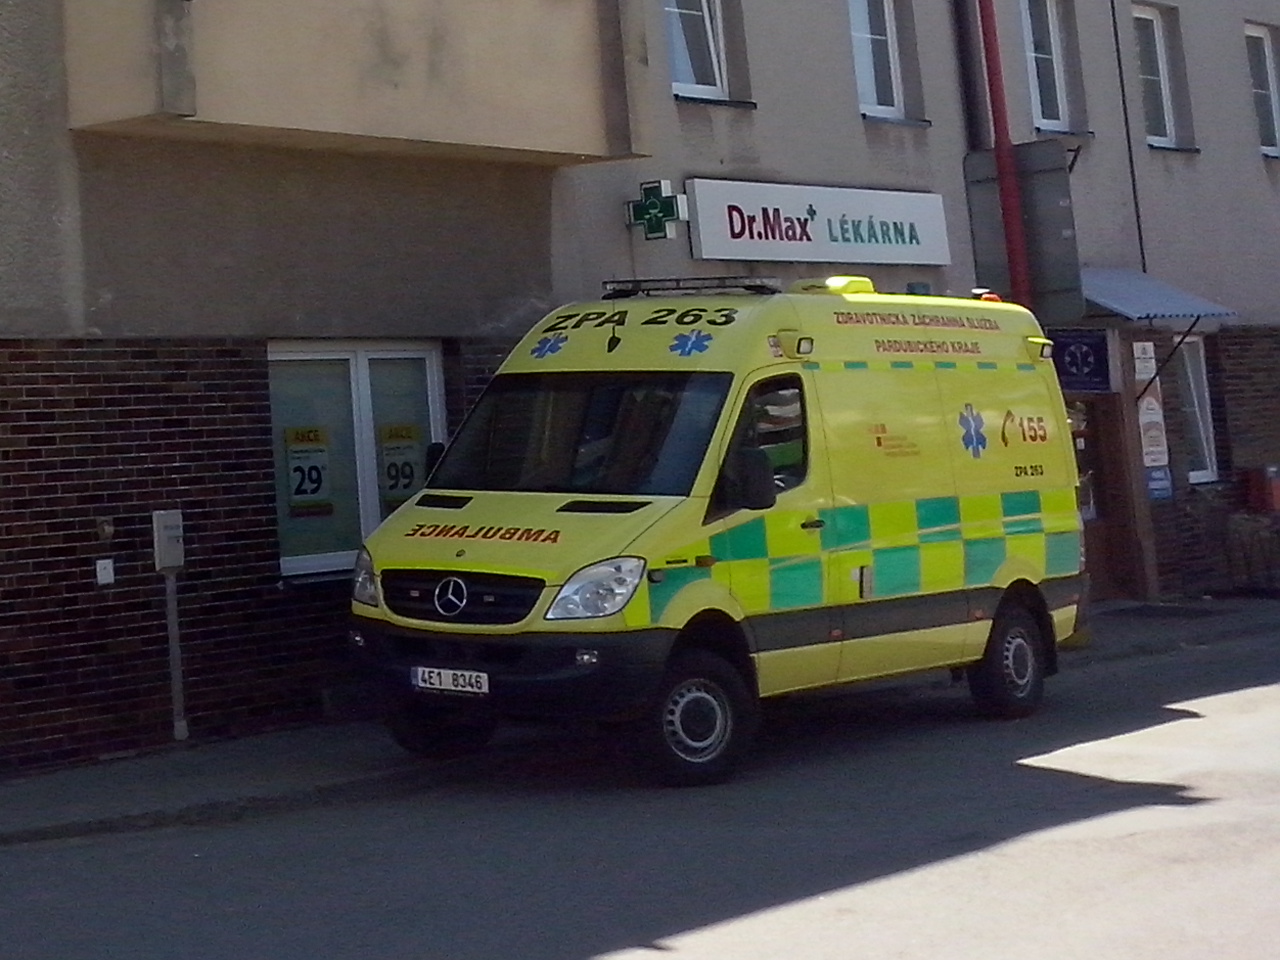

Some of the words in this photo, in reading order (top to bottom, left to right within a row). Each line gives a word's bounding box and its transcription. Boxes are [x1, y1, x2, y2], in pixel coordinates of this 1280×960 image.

[827, 214, 921, 246] LÉKÁRNA
[542, 310, 629, 333] ZPA
[641, 308, 738, 327] 263
[950, 340, 982, 354] KRAJE
[1018, 416, 1048, 443] 155
[292, 465, 323, 496] 29
[386, 461, 415, 490] 99
[1014, 465, 1028, 477] ZPA
[1030, 465, 1044, 477] 263
[420, 669, 443, 687] 4E1
[452, 672, 483, 690] 8346
